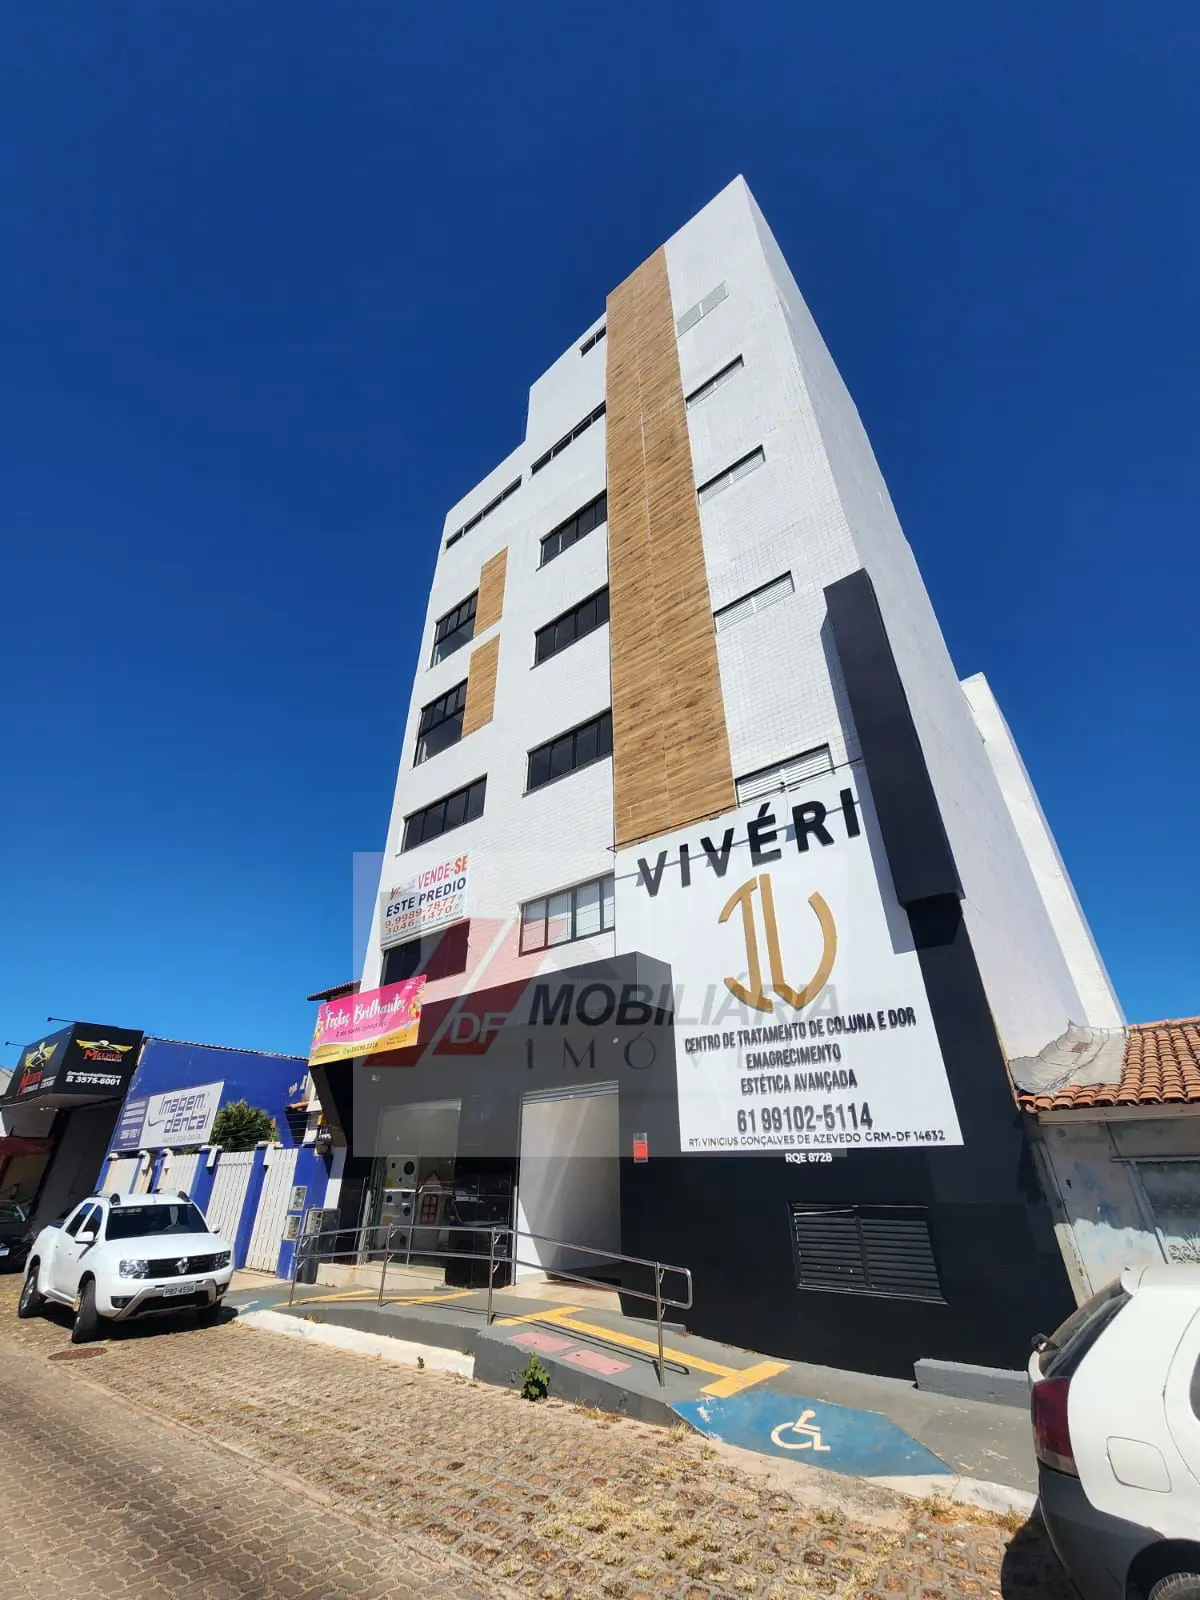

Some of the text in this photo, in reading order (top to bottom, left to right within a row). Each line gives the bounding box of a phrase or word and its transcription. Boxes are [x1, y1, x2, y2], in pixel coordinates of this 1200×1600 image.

[637, 787, 861, 898] VIVÉRI
[418, 855, 468, 889] VENDE-SE
[386, 897, 415, 917] ESTE
[685, 1006, 917, 1055] CENTRO DE TRATAMENTO DE COLUNA E DOR
[745, 1043, 842, 1072] EMAGRECIMENTO
[740, 1069, 858, 1097] ESTÉTICA AVANÇADA
[159, 1093, 206, 1118] Imagem
[737, 1102, 874, 1134] 61 99102-5114
[163, 1108, 211, 1134] dental
[740, 1134, 796, 1148] GONÇALVES
[797, 1134, 811, 1146] DE
[813, 1132, 862, 1145] AZEVEDO
[864, 1131, 912, 1143] CRM-DF
[913, 1130, 946, 1142] 14632
[785, 1152, 807, 1164] RQE
